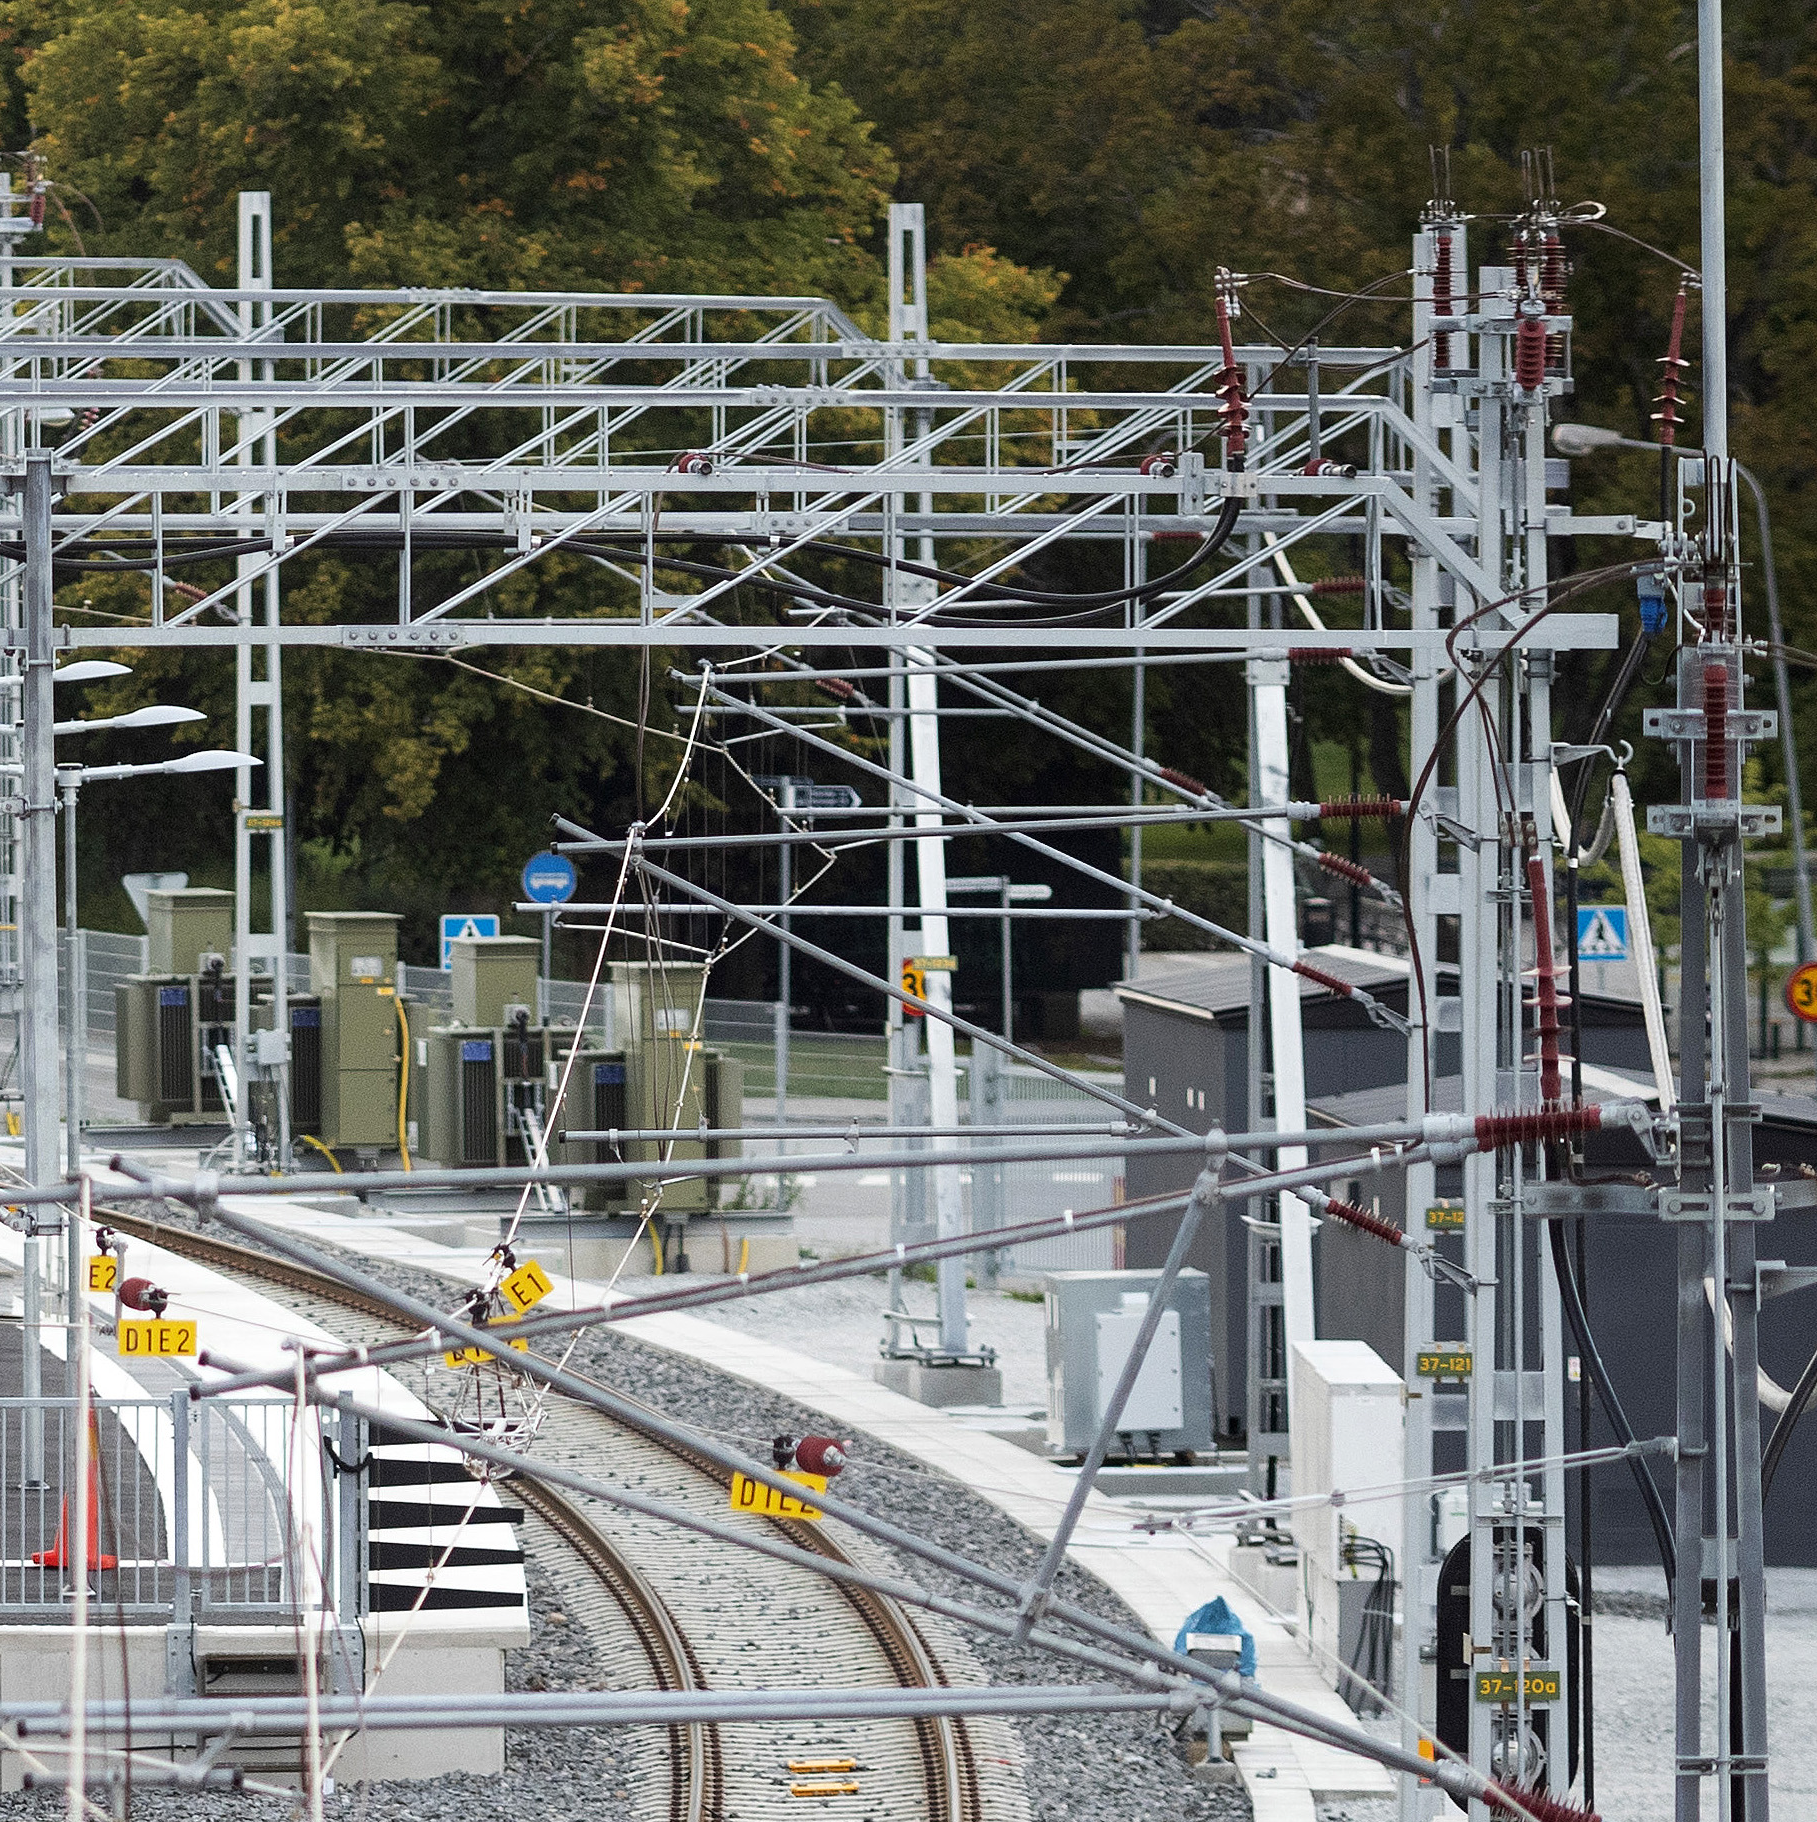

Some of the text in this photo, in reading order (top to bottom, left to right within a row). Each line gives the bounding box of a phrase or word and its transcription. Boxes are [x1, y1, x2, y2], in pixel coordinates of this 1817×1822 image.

[89, 1264, 117, 1289] E2
[510, 1272, 545, 1307] E1
[126, 1328, 190, 1353] D1E2
